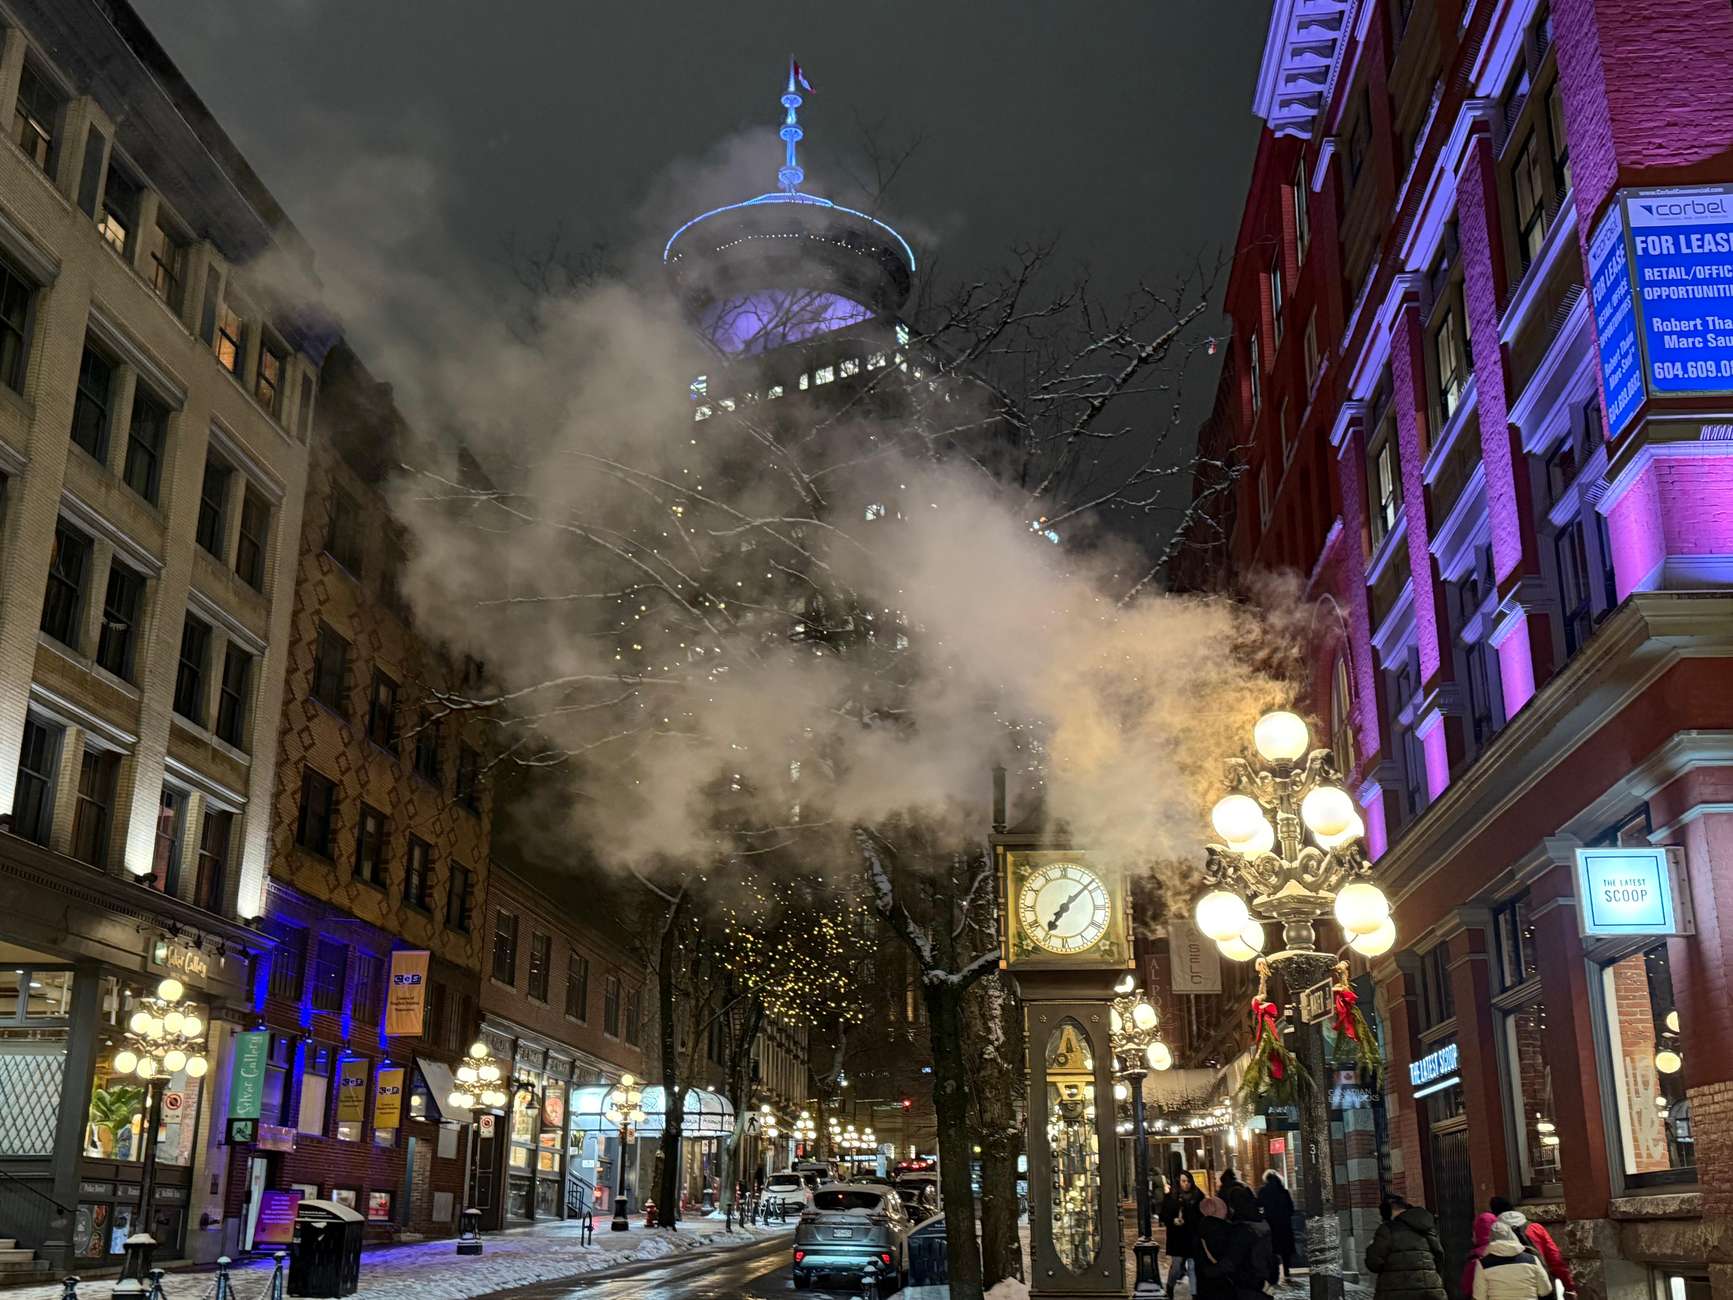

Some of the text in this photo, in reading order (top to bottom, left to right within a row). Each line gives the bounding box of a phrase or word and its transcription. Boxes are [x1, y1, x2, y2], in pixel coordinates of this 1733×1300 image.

[1656, 199, 1727, 216] corbel
[1635, 234, 1676, 256] FOR
[1593, 243, 1626, 308] FOR LEASE
[1652, 317, 1703, 333] Robert
[1663, 334, 1703, 348] Marc
[1603, 878, 1646, 887] THE LATEST
[1604, 889, 1648, 902] SCOOP
[1409, 1043, 1457, 1085] THE LATEST SCOOP
[236, 1035, 263, 1114] Silver Gallery
